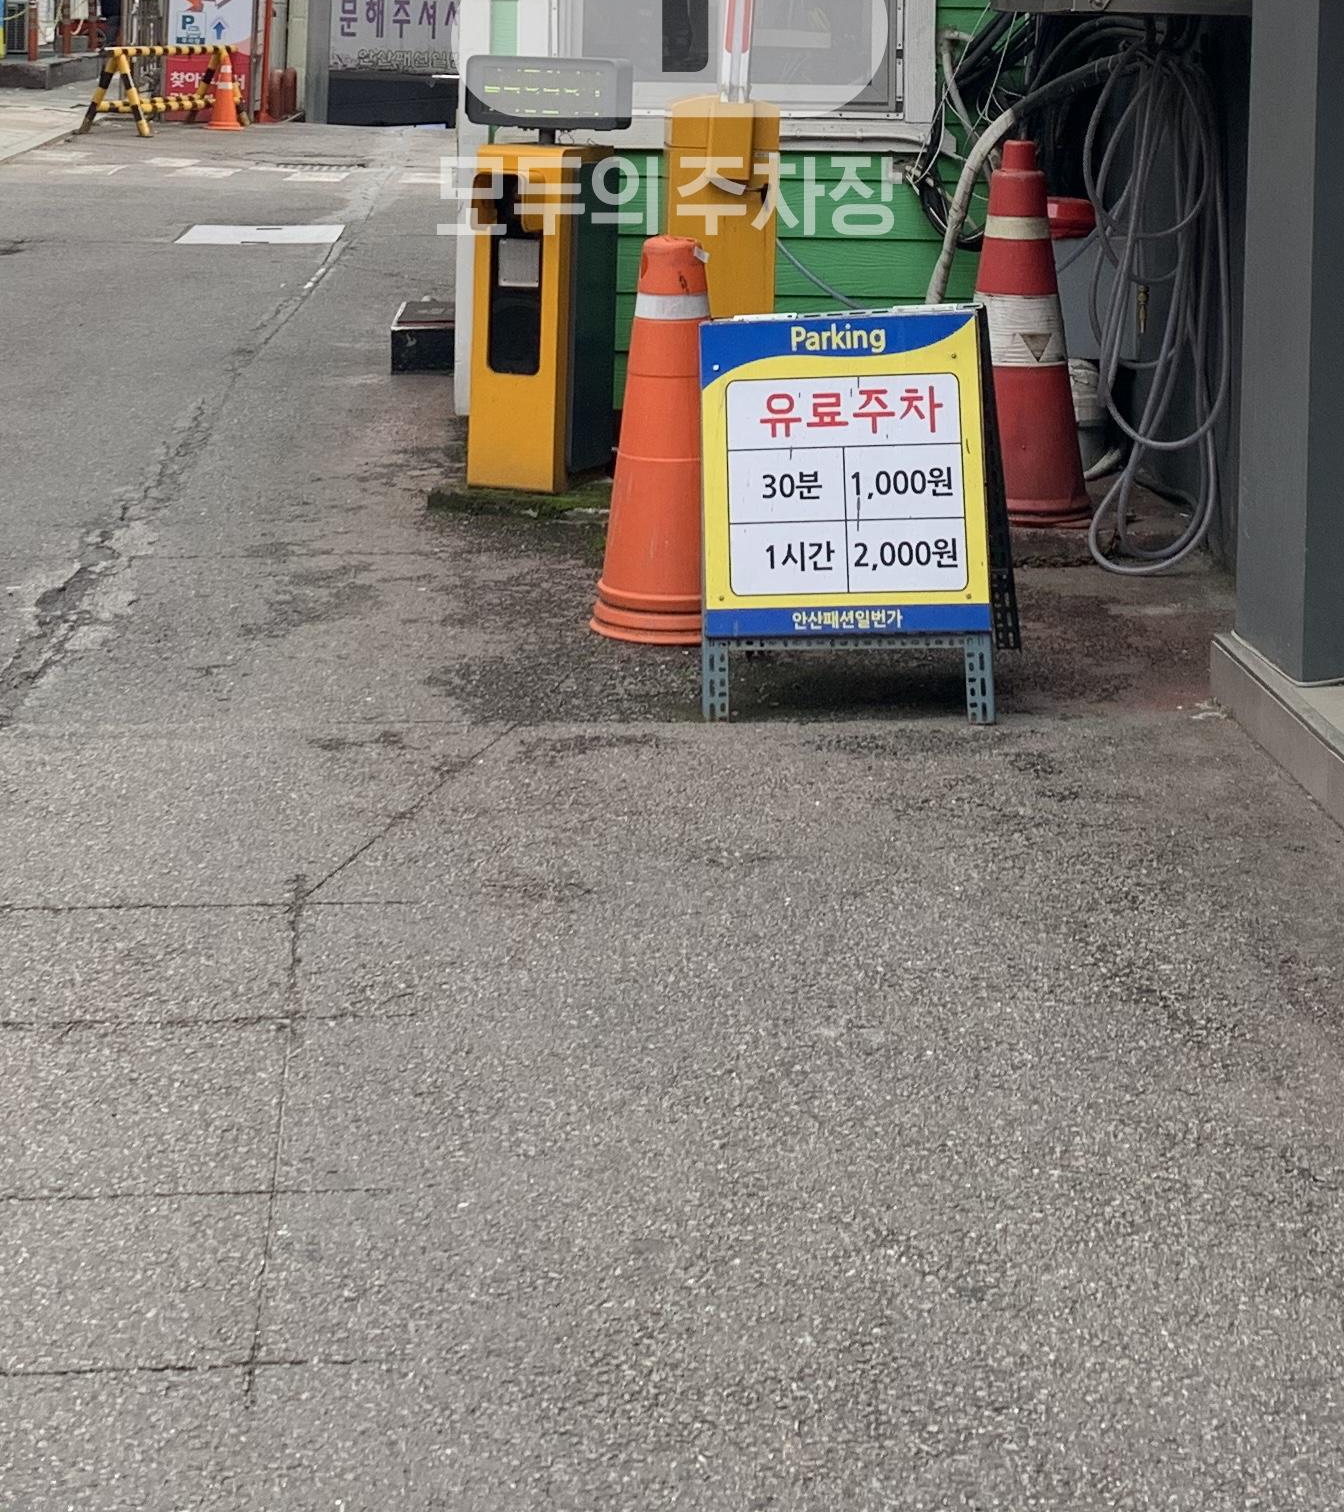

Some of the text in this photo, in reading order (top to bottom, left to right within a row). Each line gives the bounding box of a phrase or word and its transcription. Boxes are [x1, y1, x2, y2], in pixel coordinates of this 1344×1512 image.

[181, 15, 195, 30] P
[790, 325, 886, 354] Parking
[759, 385, 943, 438] 유료주차
[762, 467, 955, 500] 30분 1,000원
[765, 537, 959, 572] 1시간 2,000원
[791, 607, 903, 631] 안산패션일번가
